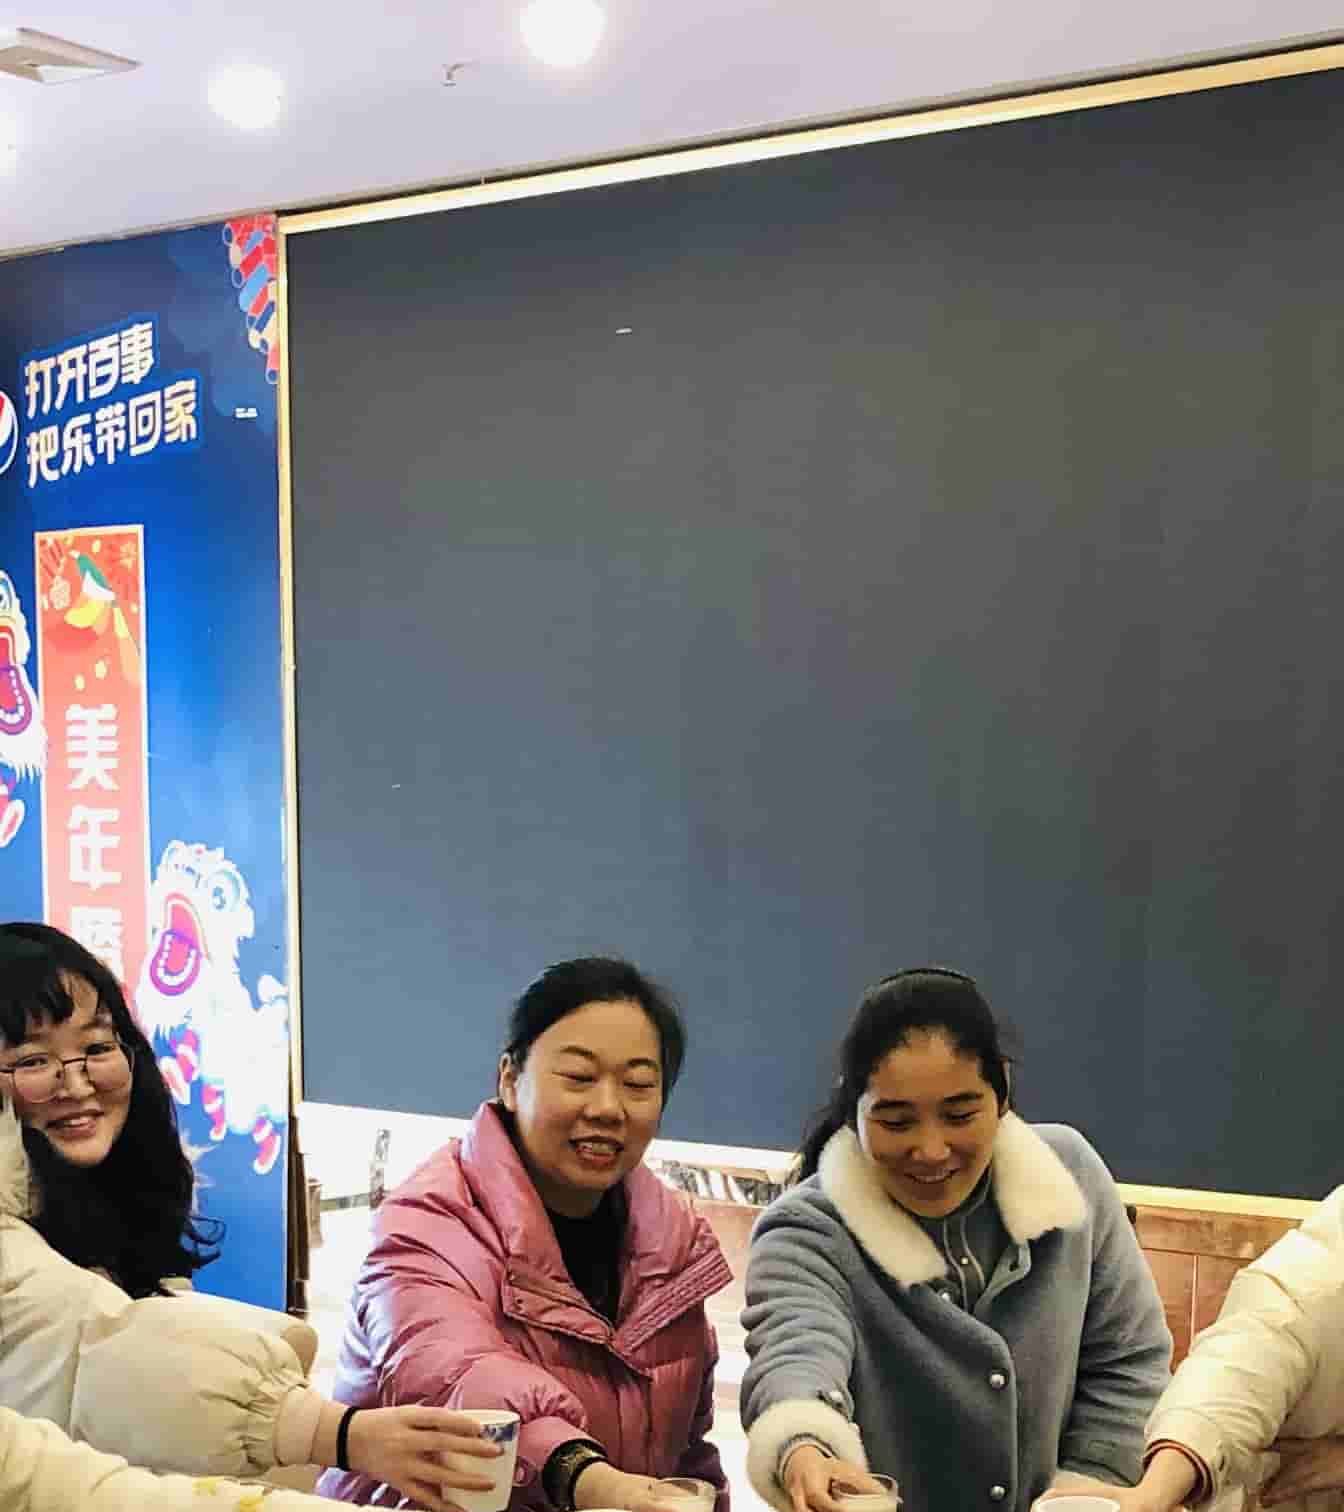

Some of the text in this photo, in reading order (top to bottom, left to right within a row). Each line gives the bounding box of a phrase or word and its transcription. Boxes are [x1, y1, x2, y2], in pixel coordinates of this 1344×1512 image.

[25, 321, 154, 419] 打开百事
[26, 378, 197, 489] 把乐带回家
